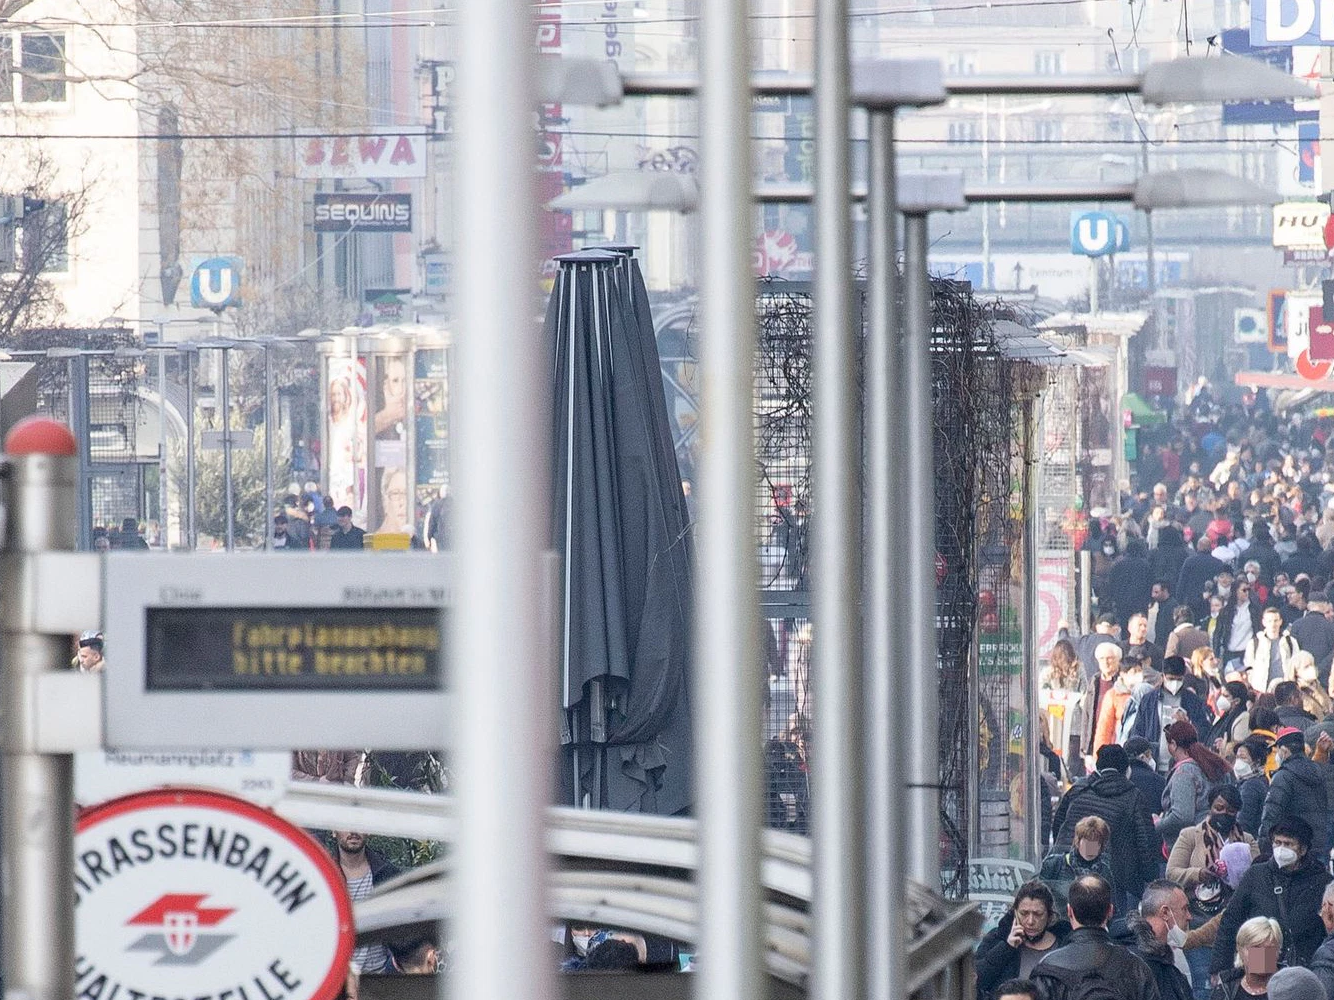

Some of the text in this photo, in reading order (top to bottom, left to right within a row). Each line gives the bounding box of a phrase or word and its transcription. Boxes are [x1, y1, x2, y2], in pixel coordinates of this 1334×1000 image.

[315, 203, 410, 225] SEQUINS
[1079, 219, 1109, 251] U
[199, 267, 232, 302] U
[233, 651, 427, 675] bitte beachten
